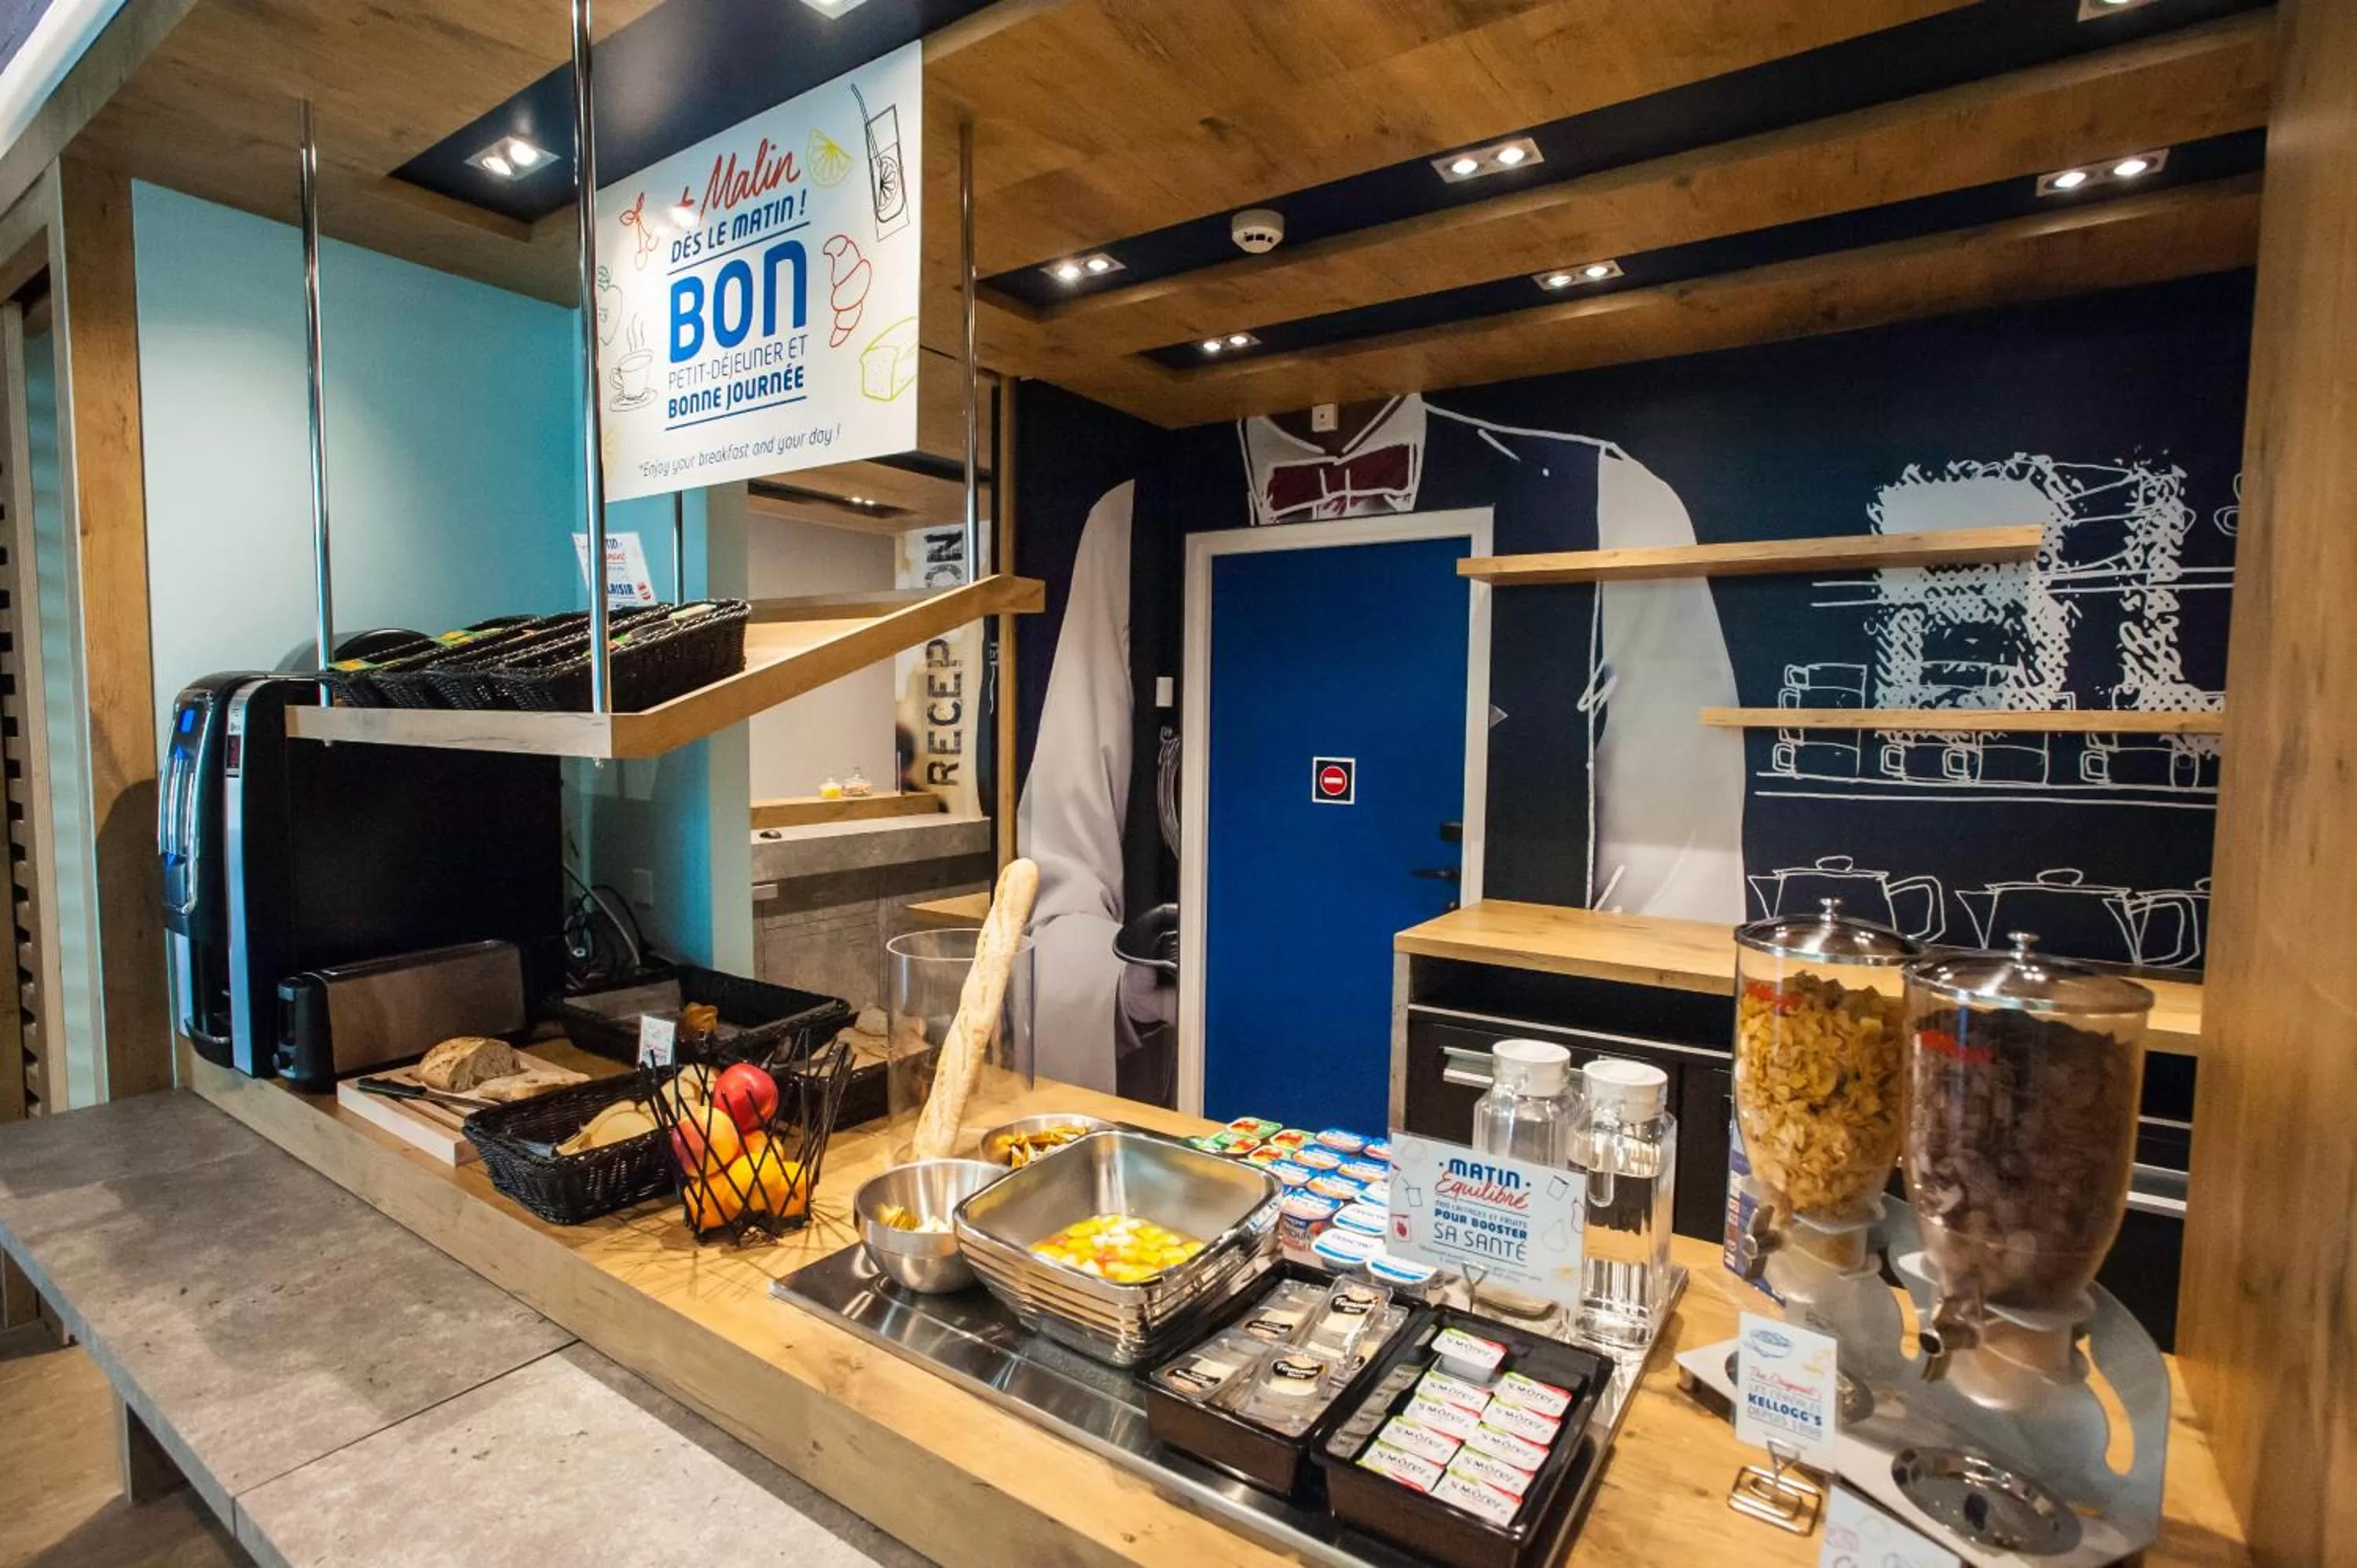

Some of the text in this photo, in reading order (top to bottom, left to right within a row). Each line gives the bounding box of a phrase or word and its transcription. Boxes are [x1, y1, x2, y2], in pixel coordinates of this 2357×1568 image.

[698, 137, 801, 225] Malin
[708, 221, 727, 249] LE
[731, 195, 794, 240] MATIN
[799, 188, 807, 215] !
[669, 239, 808, 363] BON
[669, 334, 808, 390] PETIT-DÉJEUNER ET
[669, 362, 804, 418] BONNE JOURNÉE
[672, 456, 695, 475] your
[698, 442, 750, 466] breakfast
[753, 437, 774, 456] and
[778, 433, 805, 455] your
[808, 427, 833, 447] day
[1449, 1158, 1520, 1189] MATIN
[1433, 1222, 1527, 1262] SA SANTÉ
[1434, 1207, 1528, 1240] POUR BOOSTER
[1747, 1392, 1823, 1427] KELLOGG'S
